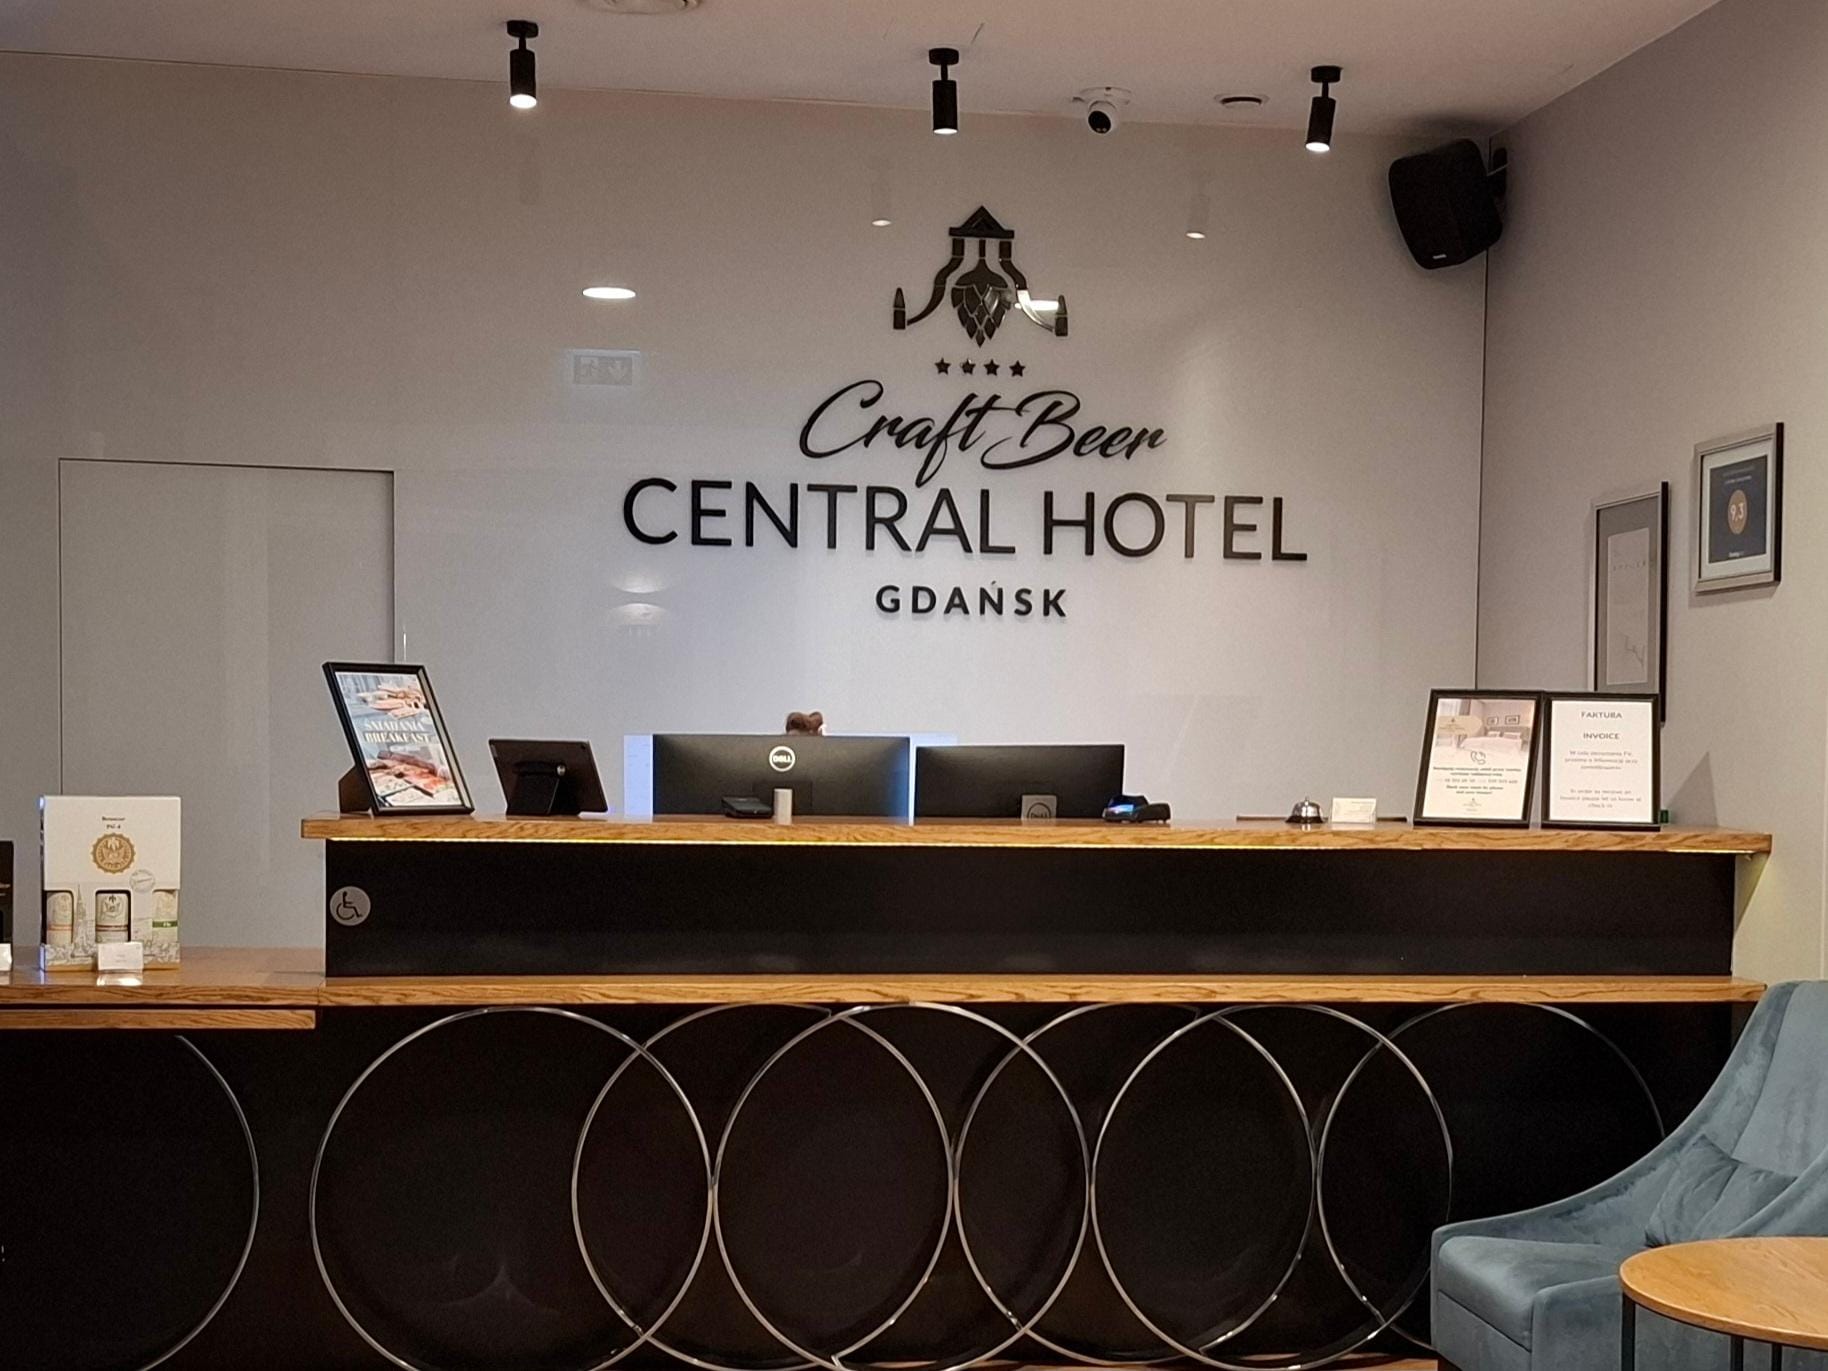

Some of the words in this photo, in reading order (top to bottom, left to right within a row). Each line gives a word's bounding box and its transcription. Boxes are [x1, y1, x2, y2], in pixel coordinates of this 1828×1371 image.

[799, 380, 1012, 488] Craft
[980, 390, 1167, 470] Beer
[622, 477, 1016, 556] CENTRAL
[1043, 491, 1308, 563] HOTEL
[876, 581, 1067, 619] GDAŃSK
[1581, 711, 1622, 719] FAKTURA
[364, 732, 429, 743] BREAKFAST
[1583, 732, 1620, 740] INVOICE
